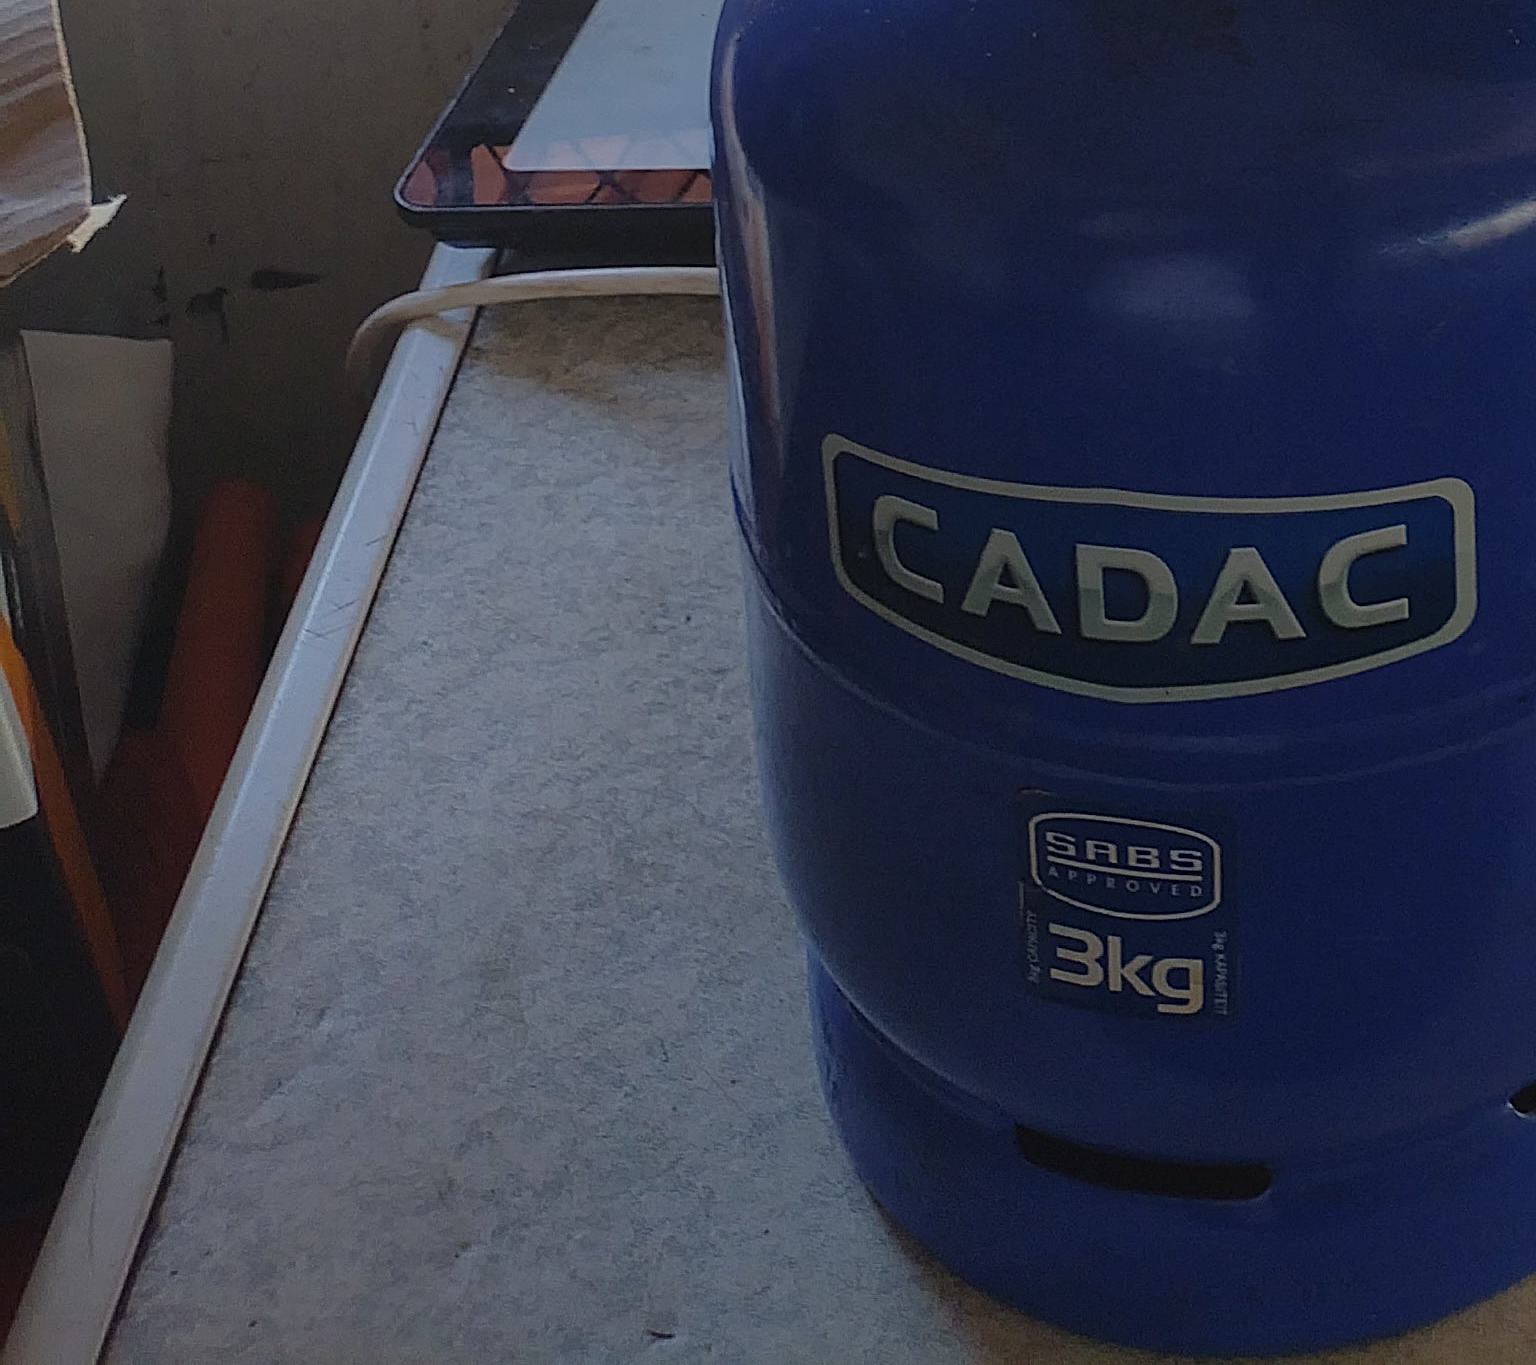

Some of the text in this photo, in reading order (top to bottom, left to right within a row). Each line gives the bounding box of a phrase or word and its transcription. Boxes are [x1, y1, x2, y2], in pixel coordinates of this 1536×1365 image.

[872, 494, 1410, 644] CADAC
[1045, 831, 1203, 872] SABS
[1047, 866, 1204, 898] APPROVED
[1048, 921, 1205, 1015] 3kg
